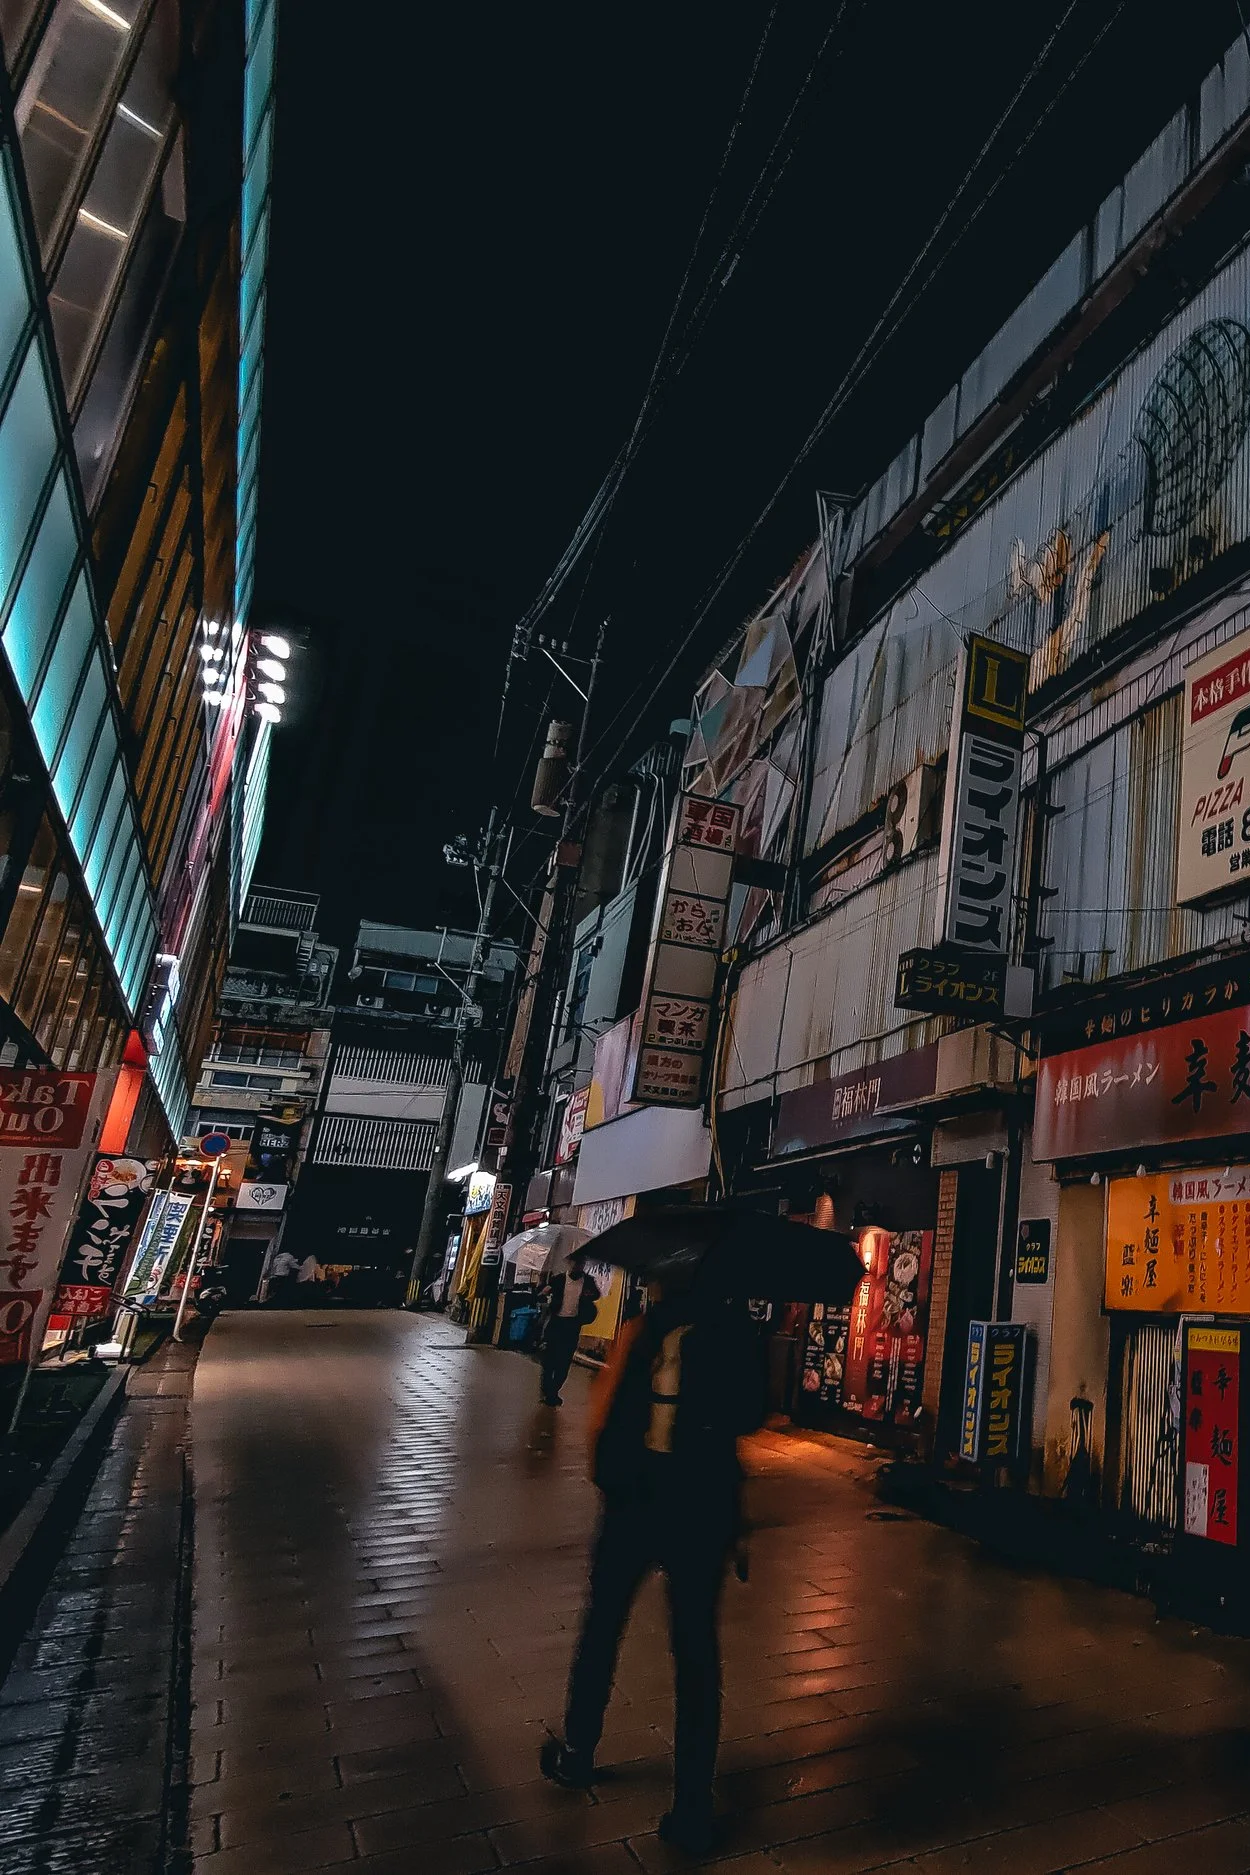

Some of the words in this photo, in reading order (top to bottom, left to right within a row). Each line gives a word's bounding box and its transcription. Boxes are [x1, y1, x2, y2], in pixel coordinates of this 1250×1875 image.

[982, 656, 1018, 713] L
[1191, 777, 1244, 828] PIZZA
[1200, 814, 1234, 858] 電話
[653, 1002, 707, 1022] マンガ
[1054, 1061, 1160, 1106] 韓国風ラーメン
